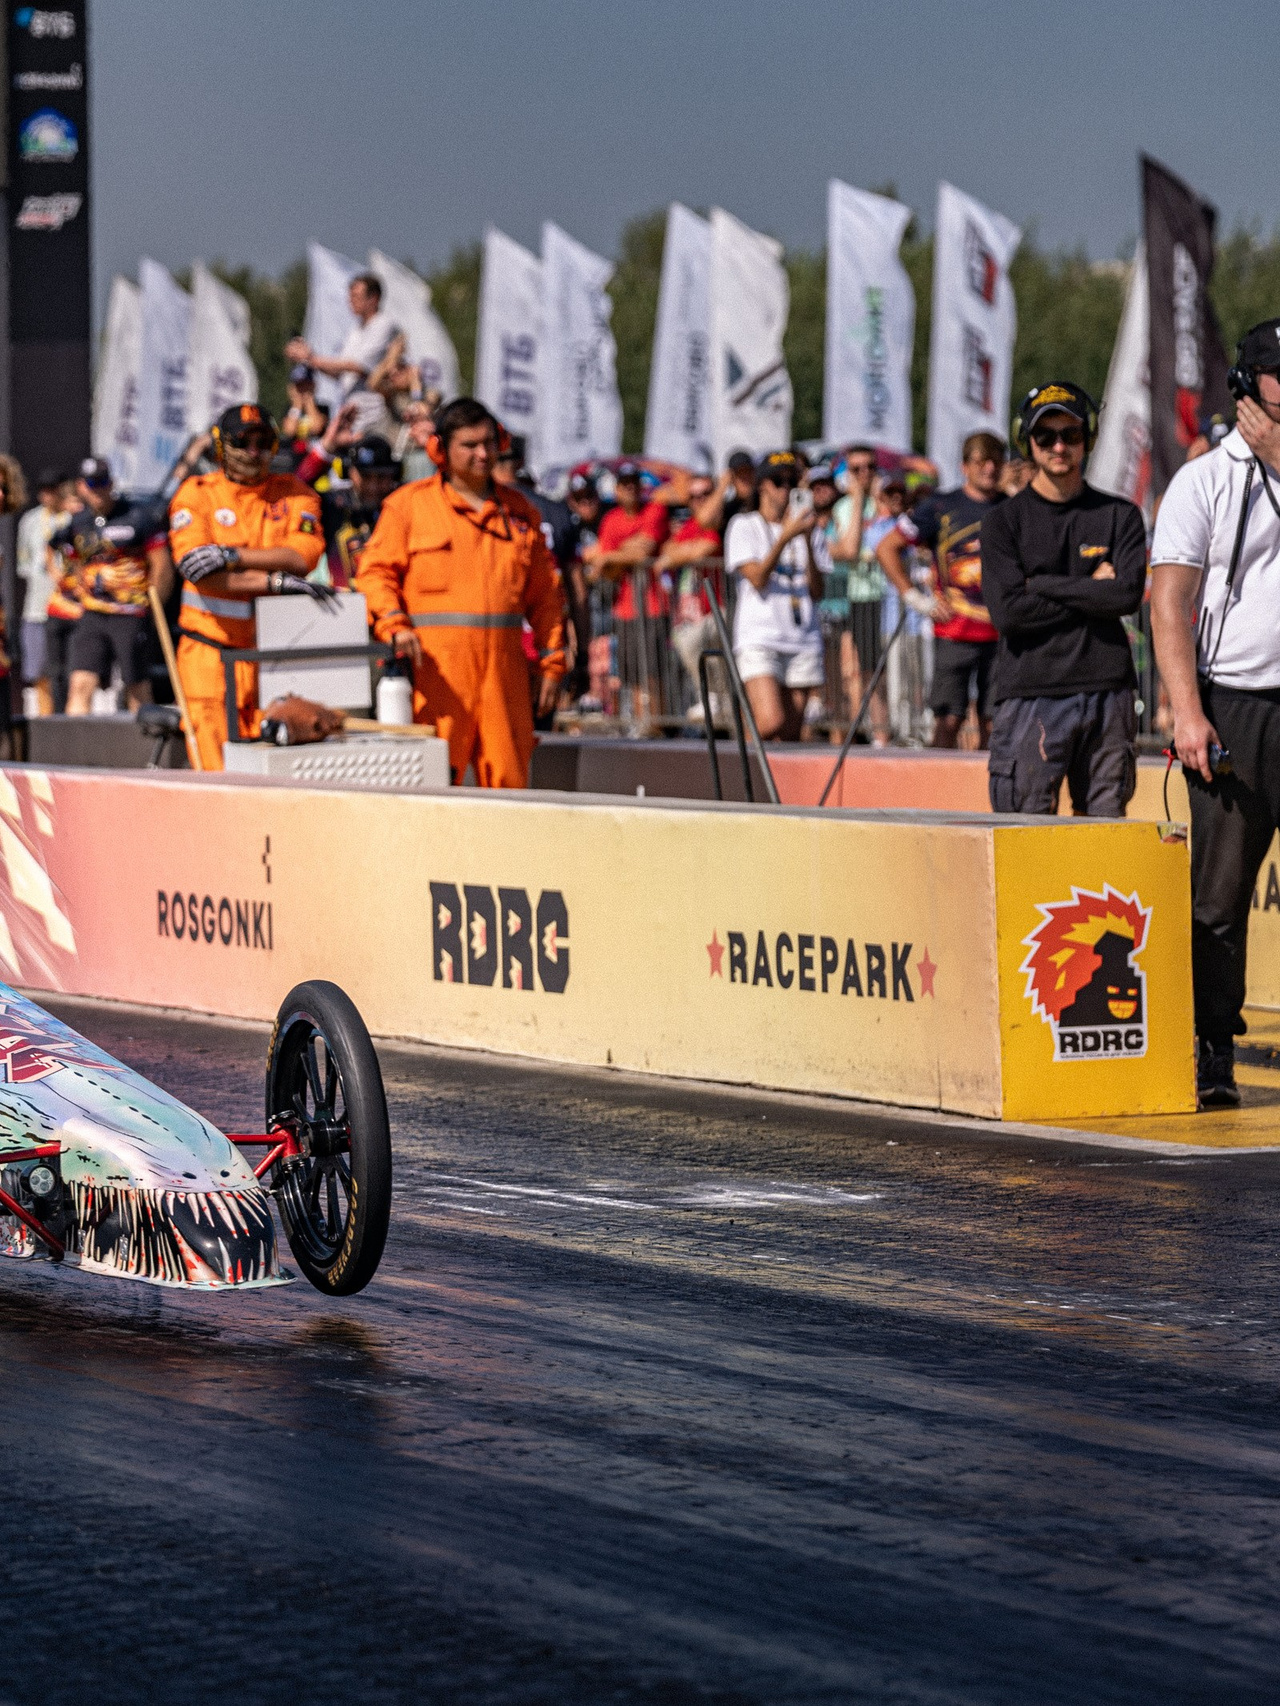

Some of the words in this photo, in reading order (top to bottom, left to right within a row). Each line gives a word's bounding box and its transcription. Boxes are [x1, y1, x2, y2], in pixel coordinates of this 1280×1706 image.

[157, 889, 273, 951] ROSGONKI
[429, 880, 571, 994] RDRC
[727, 930, 916, 1003] RACEPARK
[1058, 1028, 1144, 1054] RDRC
